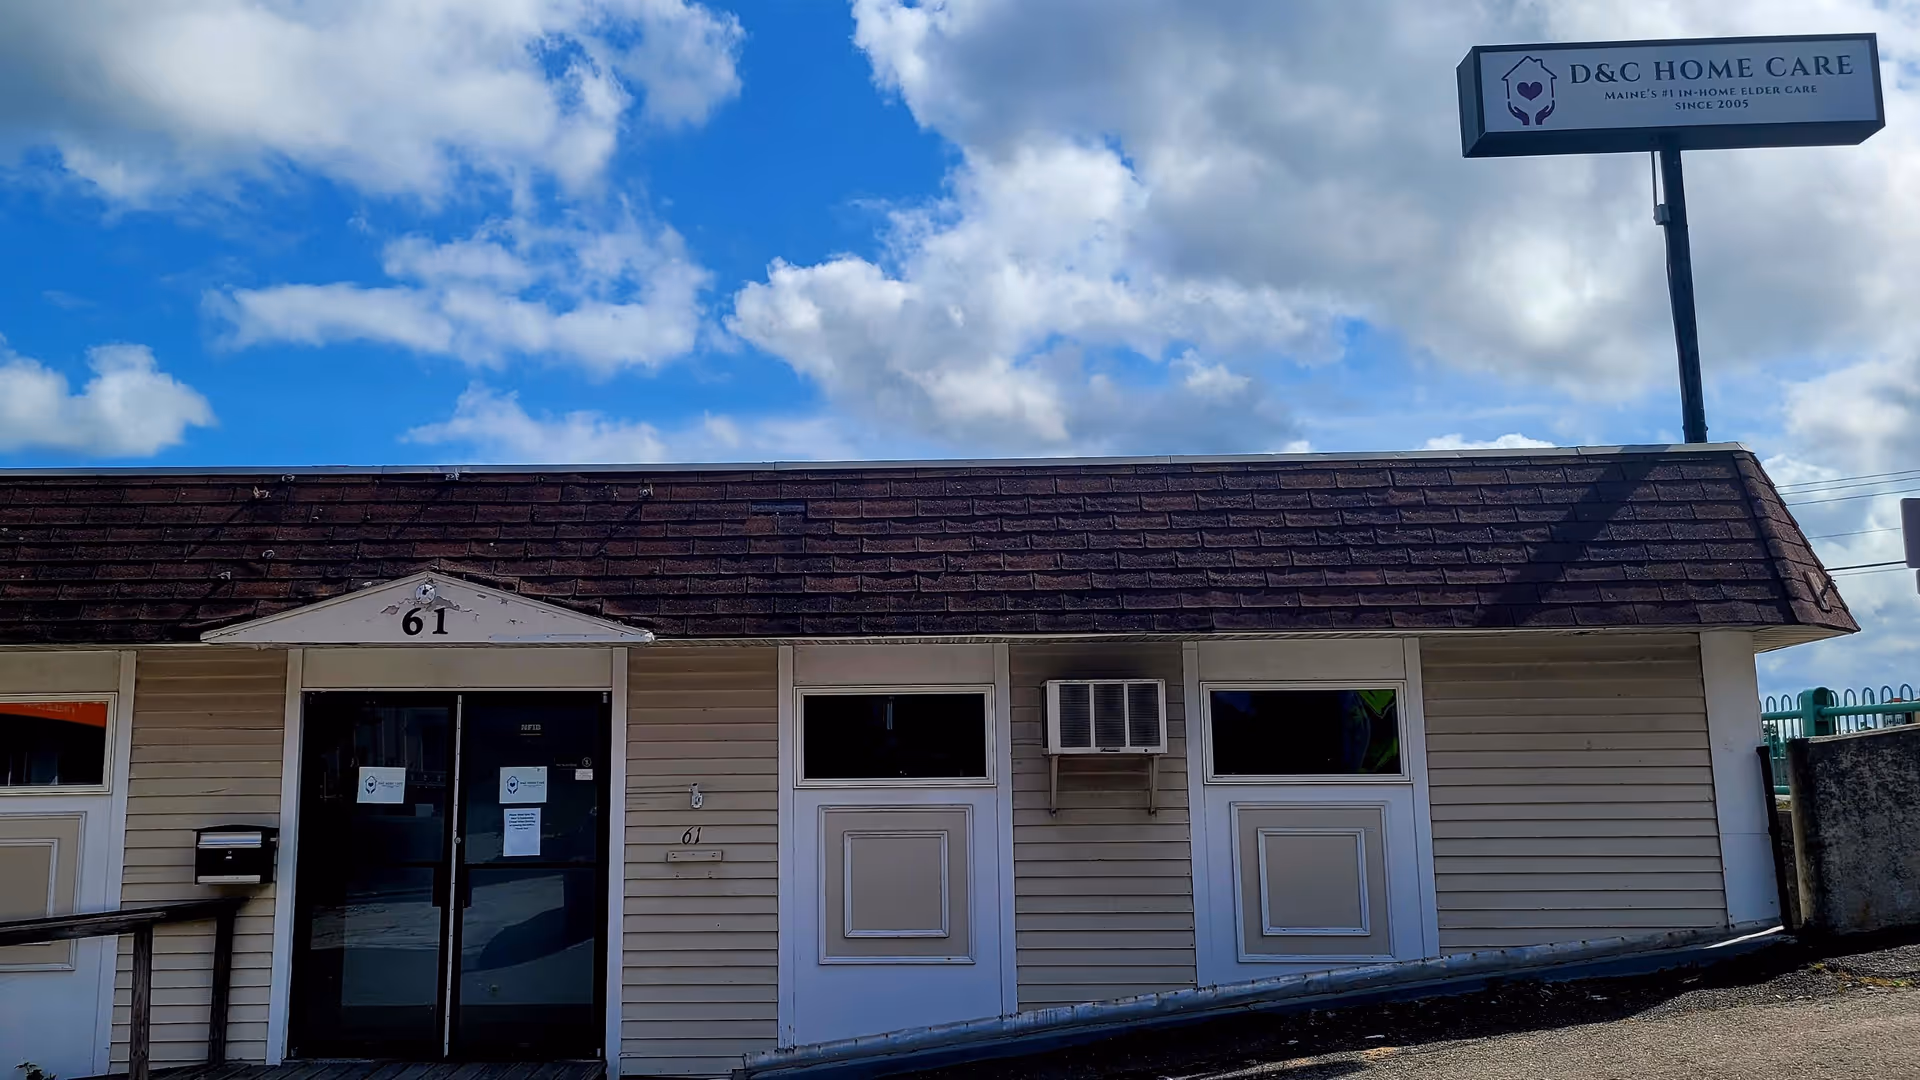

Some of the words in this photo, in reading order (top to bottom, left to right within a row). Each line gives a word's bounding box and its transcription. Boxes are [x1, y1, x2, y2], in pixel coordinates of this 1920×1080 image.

[1569, 61, 1641, 84] D&C
[1653, 57, 1754, 81] HOME
[1765, 54, 1854, 78] CARE
[1604, 88, 1657, 100] MAINE'S
[1661, 89, 1674, 98] #1
[1678, 87, 1736, 98] IN-HOME
[1741, 86, 1781, 96] ELDER
[1784, 84, 1818, 94] CARE
[1674, 100, 1713, 110] SINCE
[1717, 98, 1749, 109] 2005
[402, 607, 449, 636] 61
[681, 826, 702, 845] 61
